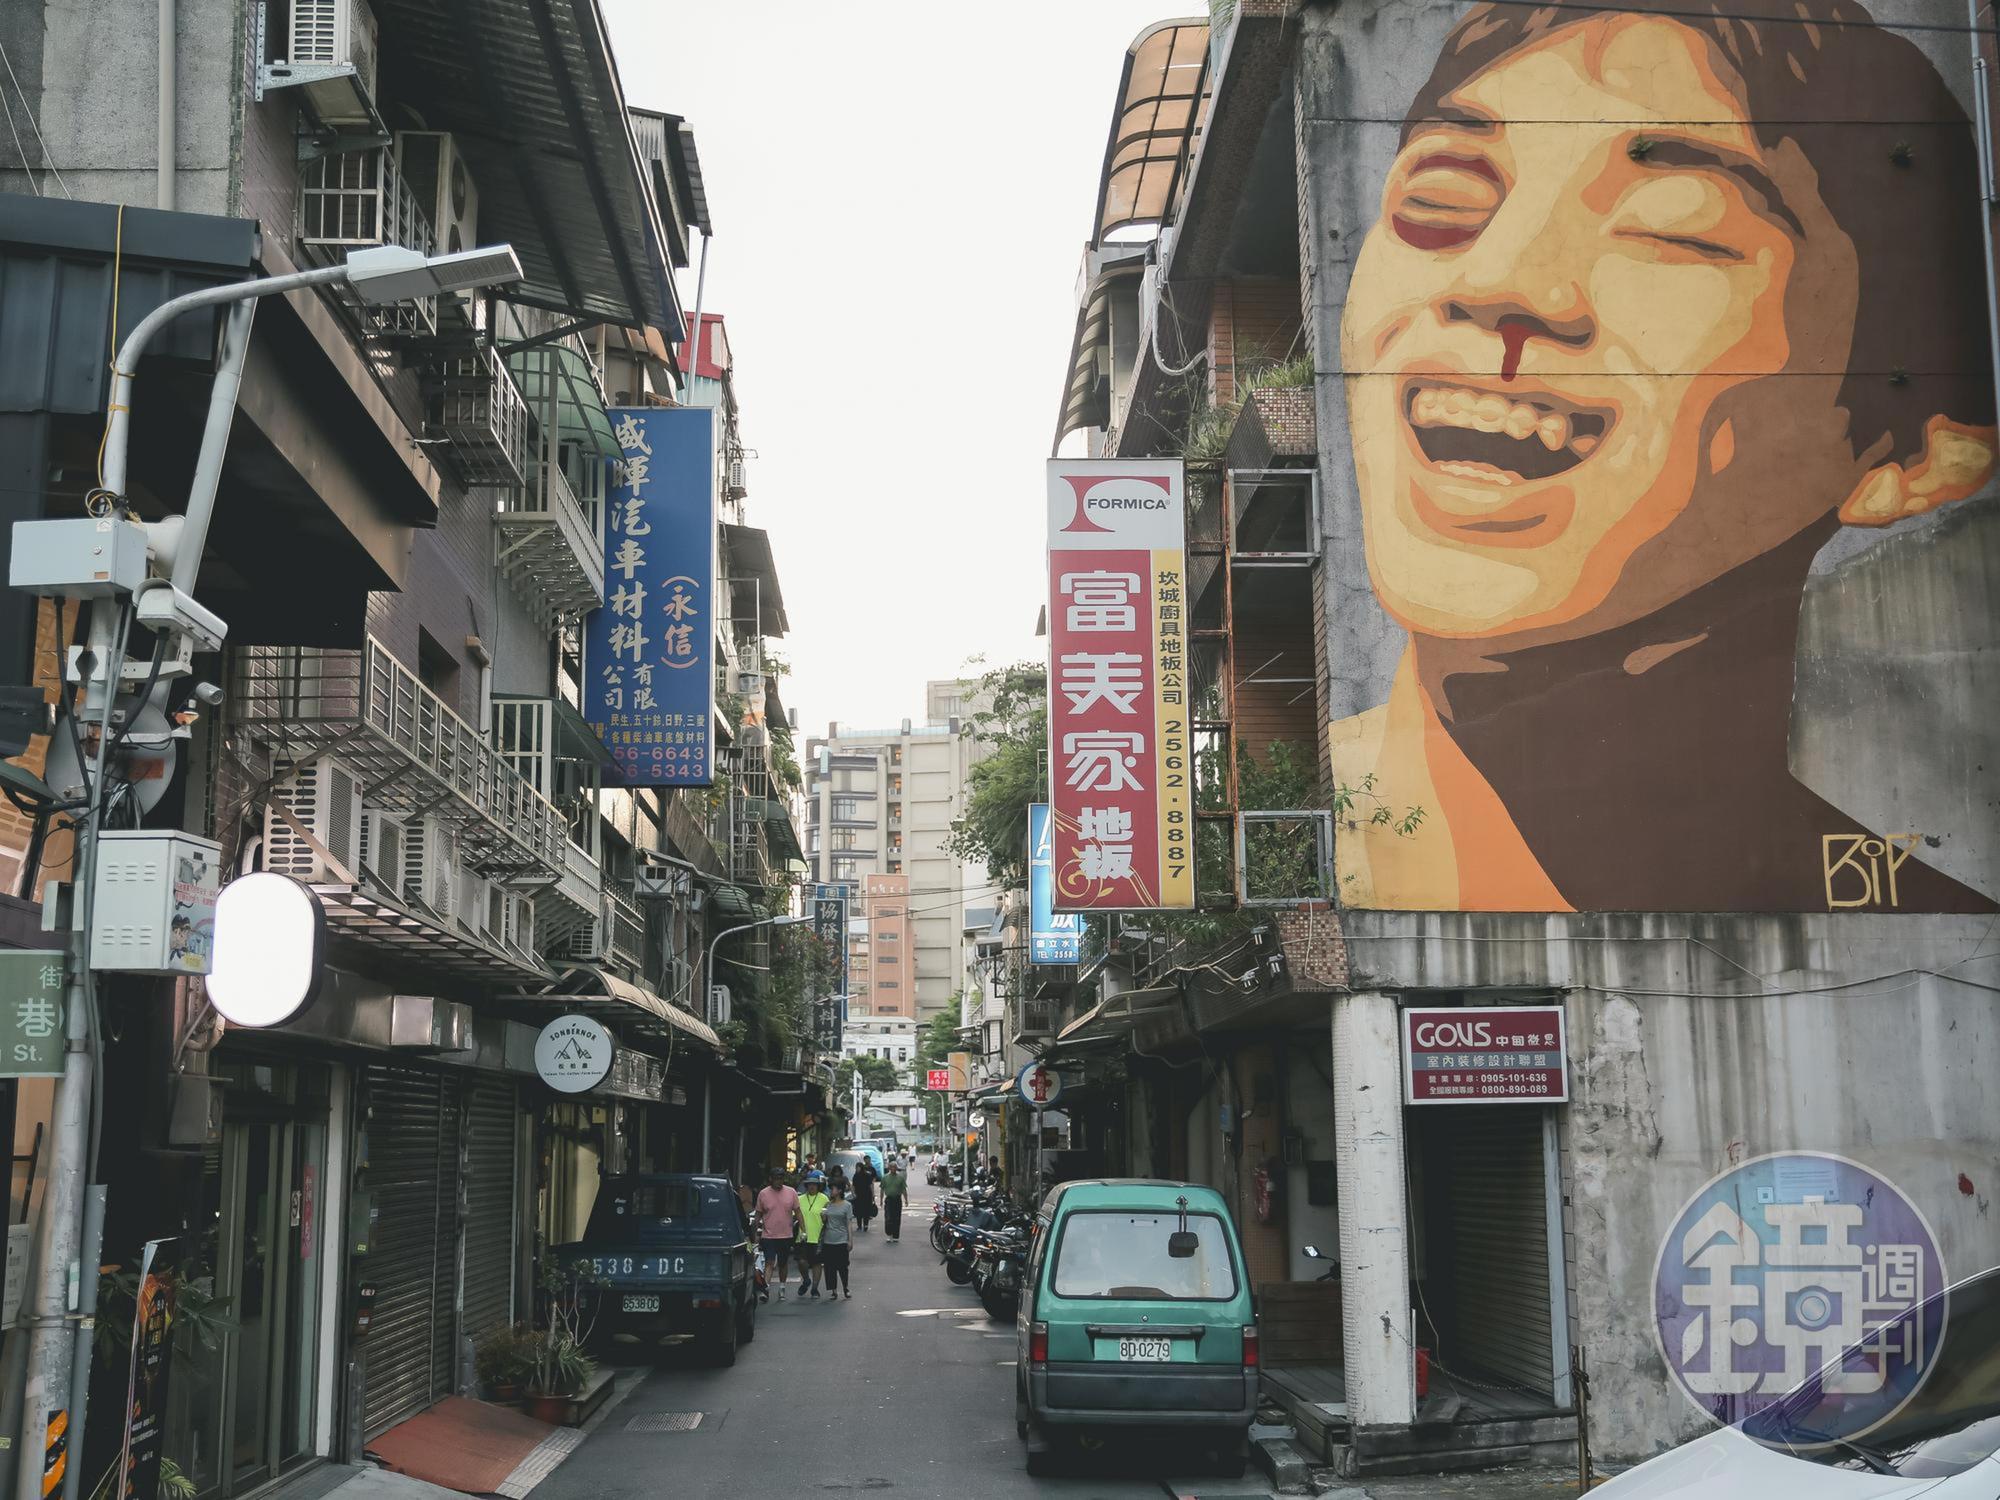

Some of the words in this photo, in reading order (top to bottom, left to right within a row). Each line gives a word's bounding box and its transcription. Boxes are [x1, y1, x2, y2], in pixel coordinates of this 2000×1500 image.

[1087, 498, 1166, 510] FORMICA
[607, 747, 704, 760] 56-6643
[40, 965, 63, 989] 街
[16, 998, 56, 1037] 巷
[13, 1044, 43, 1062] St.
[1427, 1054, 1546, 1067] 室內裝修設計聯盟
[1481, 1084, 1548, 1094] 0800-890-089
[1121, 1342, 1170, 1357] 8D-0279
